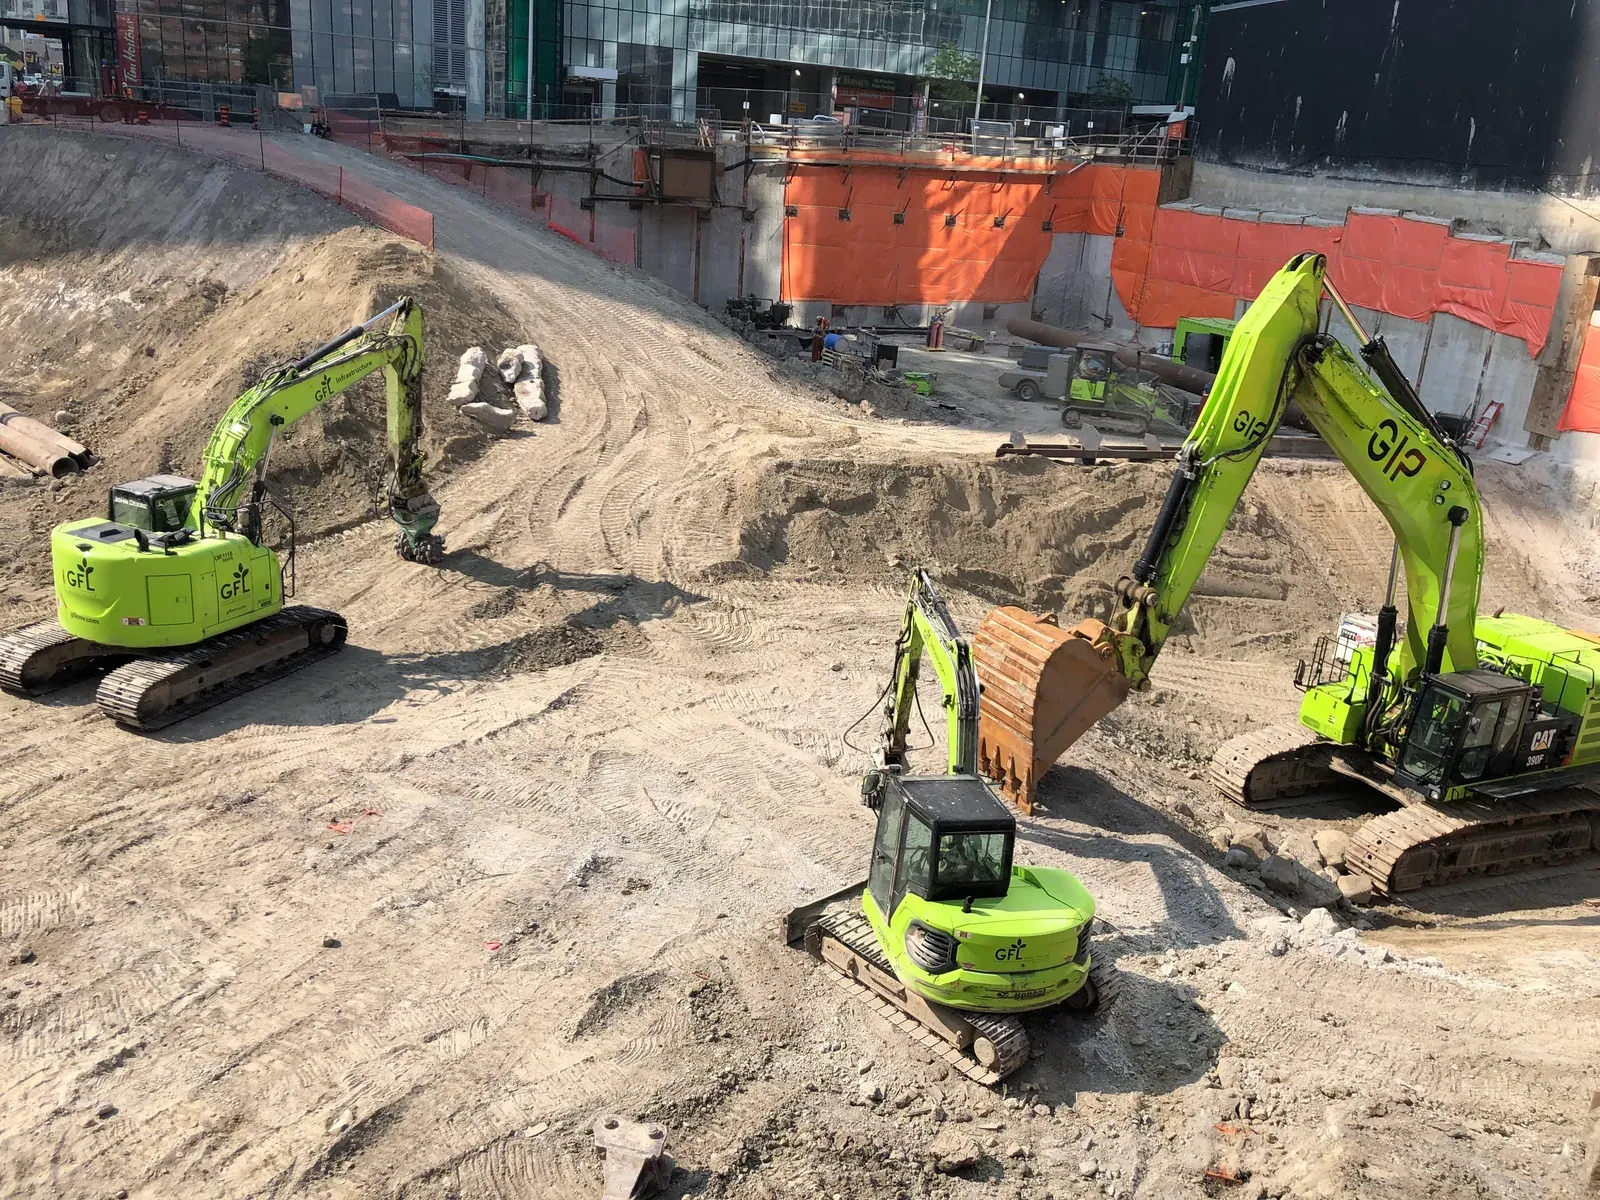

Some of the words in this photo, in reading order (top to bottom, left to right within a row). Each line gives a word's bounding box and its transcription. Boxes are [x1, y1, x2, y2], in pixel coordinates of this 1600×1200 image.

[123, 64, 138, 83] Tim
[314, 376, 335, 402] GFL
[335, 360, 373, 384] Infrastructure
[66, 563, 96, 592] GFL
[220, 568, 251, 600] GFL
[1530, 728, 1557, 752] CAT
[995, 944, 1027, 961] GFL
